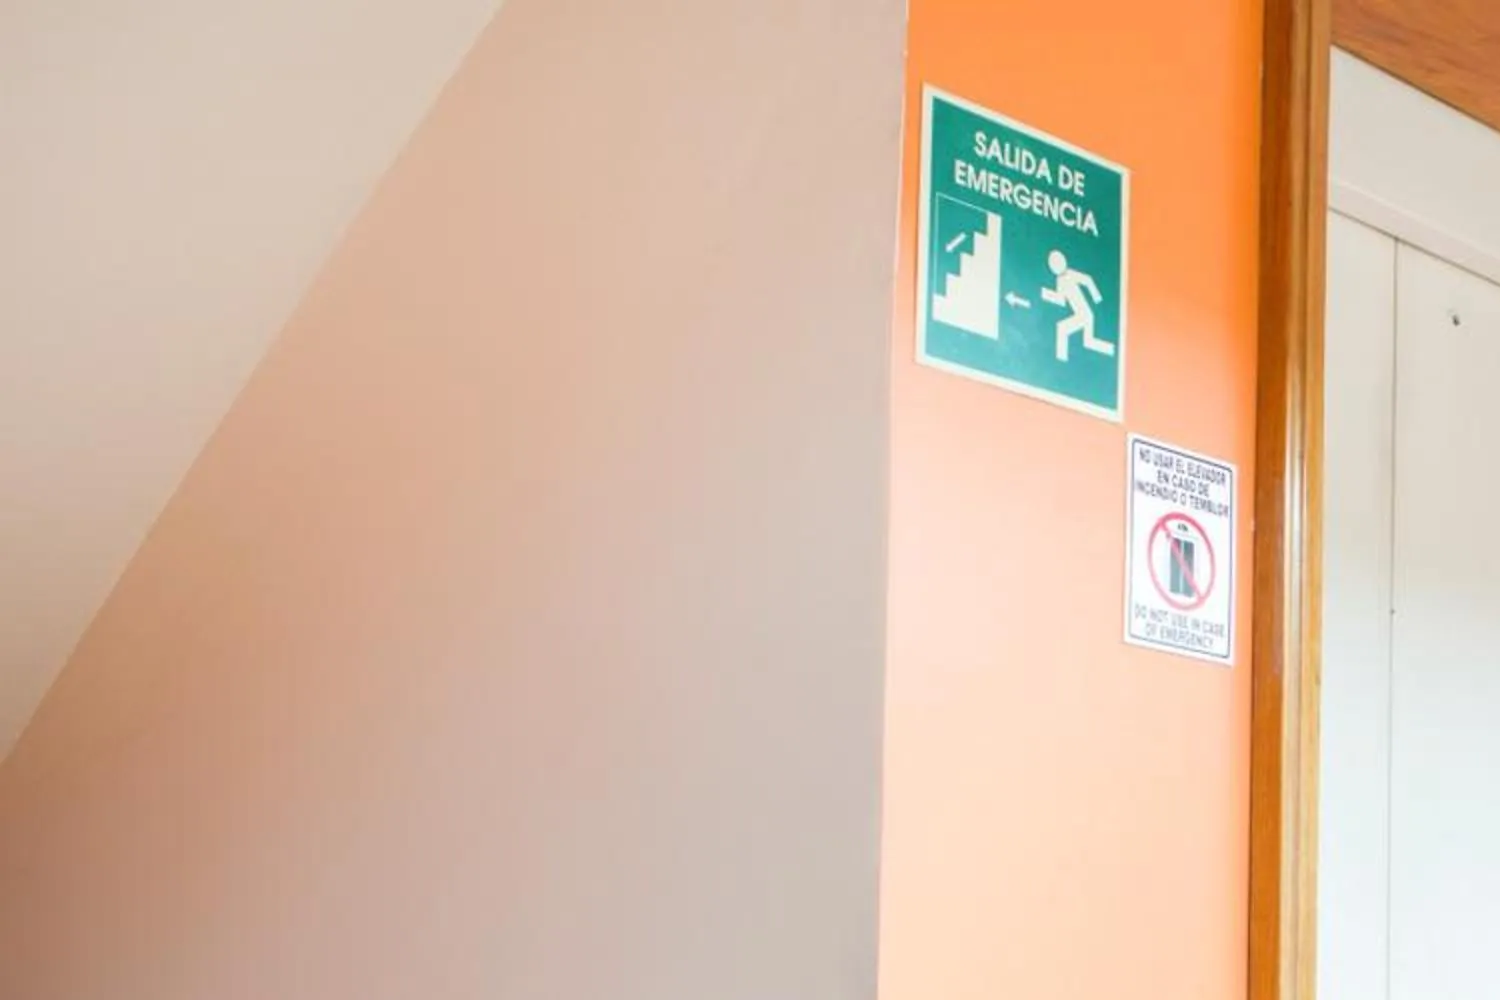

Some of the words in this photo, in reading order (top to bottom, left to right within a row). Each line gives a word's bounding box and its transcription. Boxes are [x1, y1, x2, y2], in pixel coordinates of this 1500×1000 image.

[973, 131, 1052, 184] SALIDA
[1058, 164, 1085, 197] DE
[954, 158, 1098, 237] EMERGENCIA
[1139, 447, 1150, 463] NO
[1153, 452, 1173, 468] USAR
[1176, 458, 1185, 474] EL
[1157, 469, 1169, 484] EN
[1171, 474, 1196, 493] CASO
[1198, 481, 1209, 498] DE
[1180, 492, 1187, 506] O
